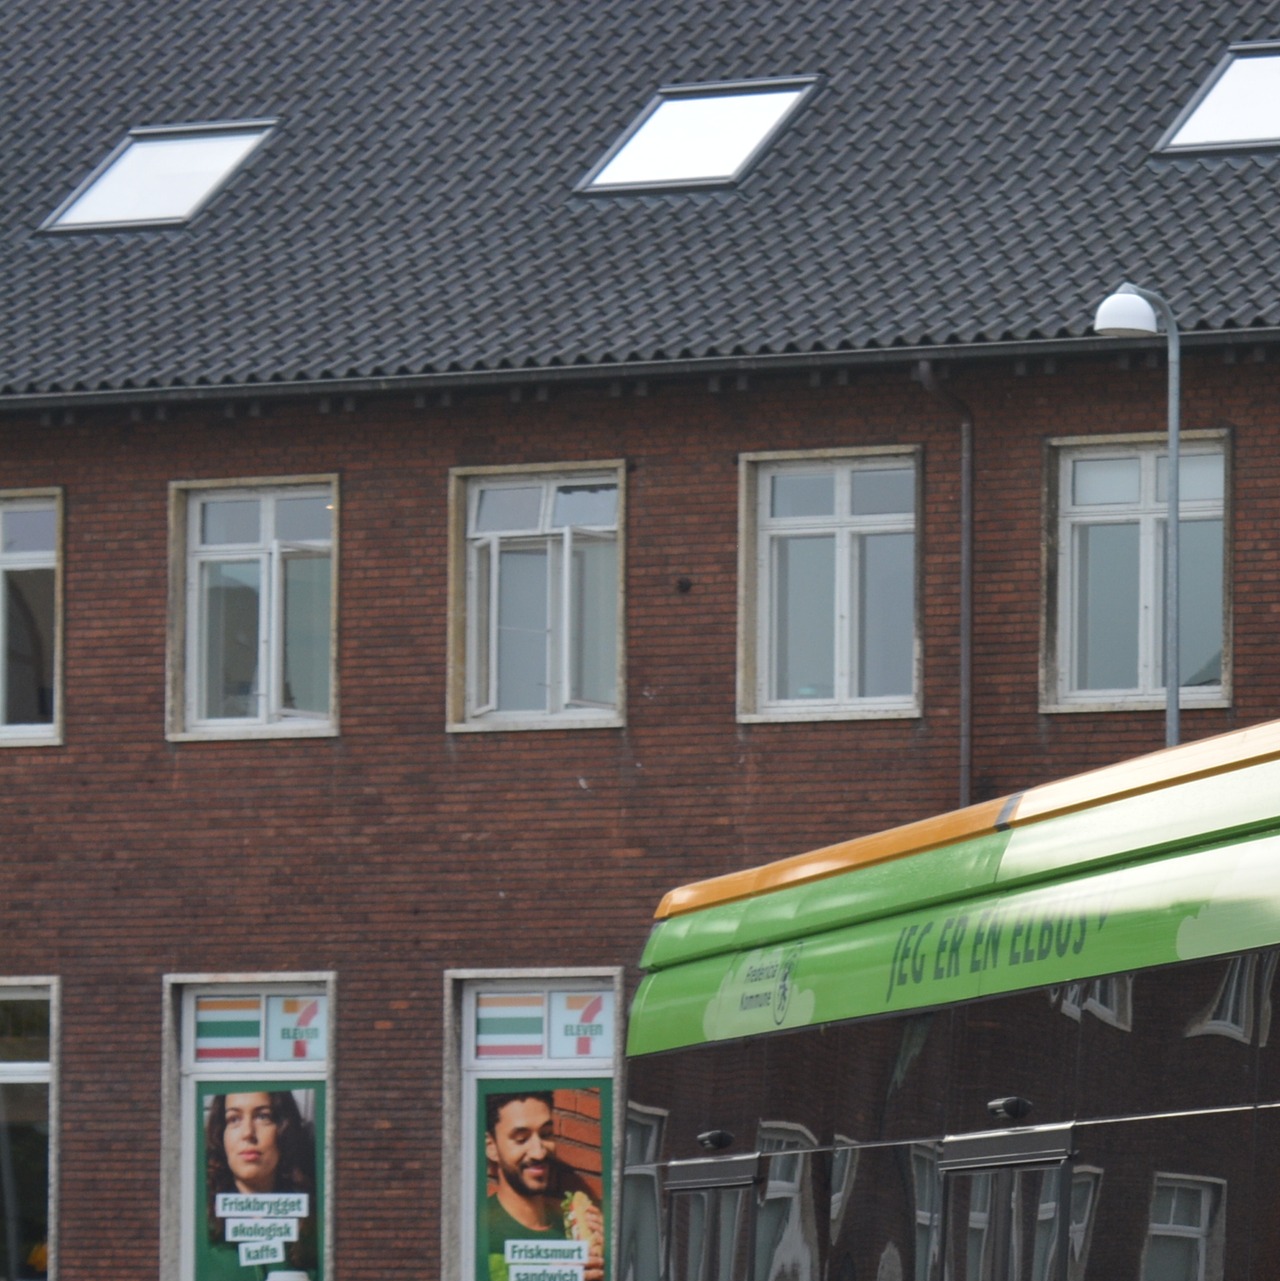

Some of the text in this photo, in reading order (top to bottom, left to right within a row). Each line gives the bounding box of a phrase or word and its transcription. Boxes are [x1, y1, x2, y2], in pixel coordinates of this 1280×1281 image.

[886, 894, 1092, 1004] JEG ER EN ELBUS
[281, 1027, 319, 1039] ELEVEN
[563, 1024, 603, 1036] ELEVEN
[221, 1197, 302, 1215] Friskbrygget
[231, 1222, 292, 1240] økologisk
[244, 1244, 279, 1261] kaffe
[511, 1244, 583, 1260] Frisksmurt
